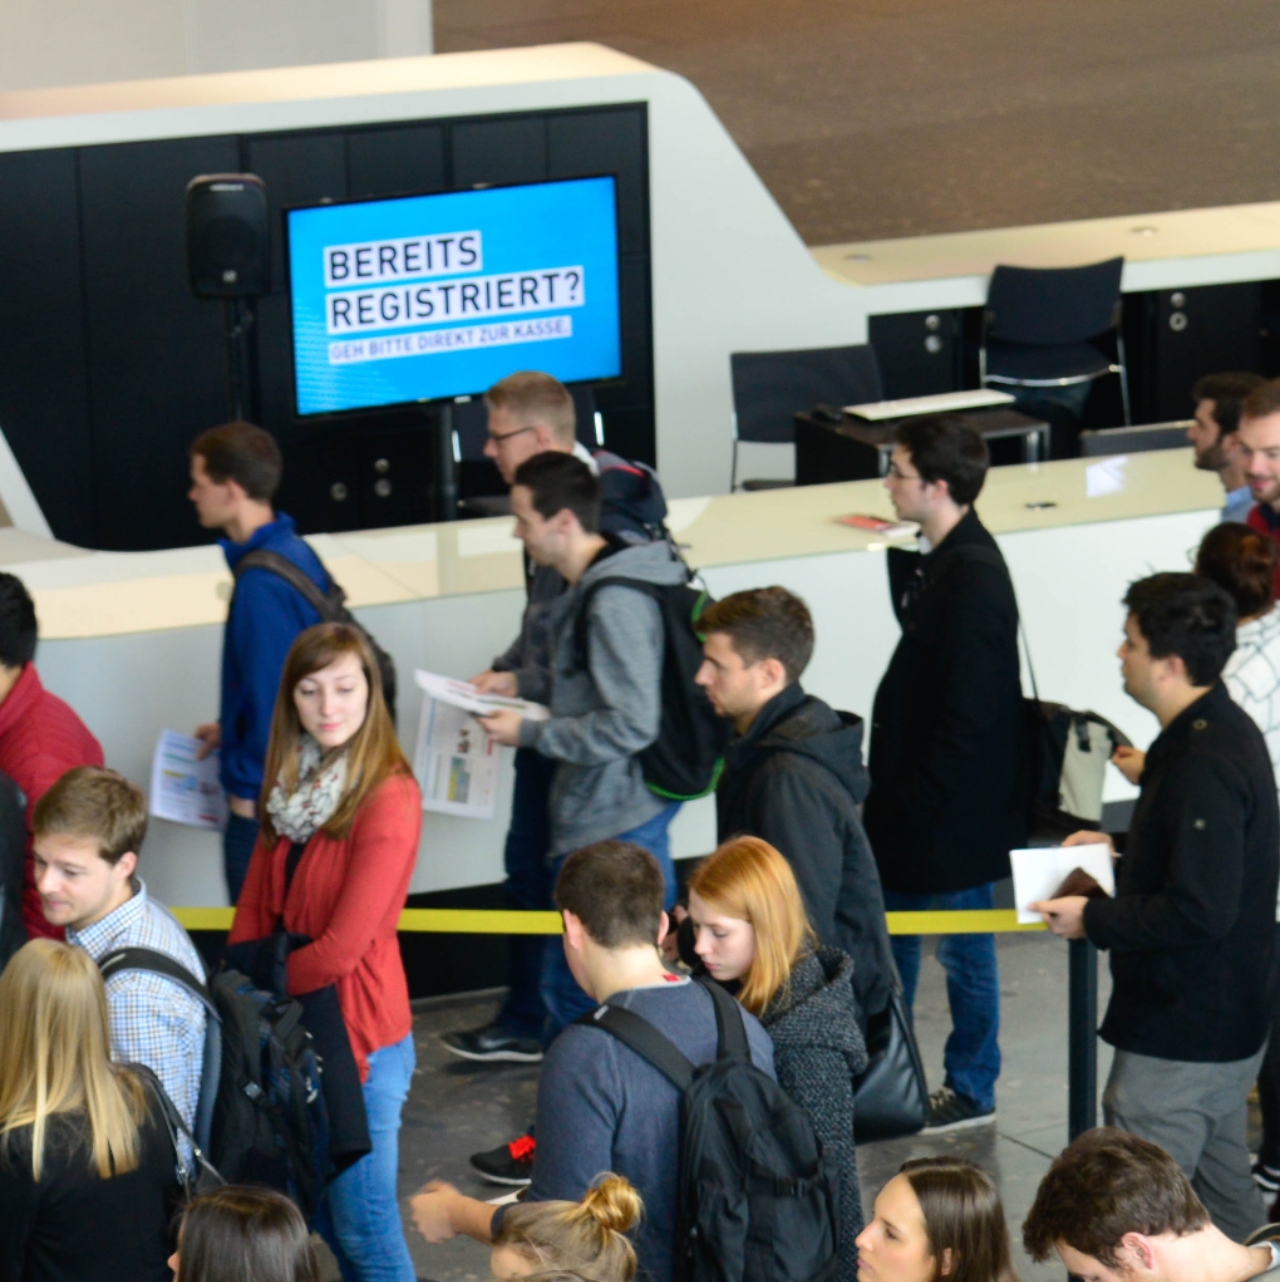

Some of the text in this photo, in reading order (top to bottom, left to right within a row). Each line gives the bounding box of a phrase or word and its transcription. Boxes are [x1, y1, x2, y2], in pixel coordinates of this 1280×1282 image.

[329, 236, 477, 280] BEREITS
[332, 271, 580, 327] REGISTRIERT?
[332, 343, 364, 360] GEH
[369, 336, 411, 355] BITTE
[418, 329, 474, 349] DIREKT
[479, 325, 509, 342] ZUR
